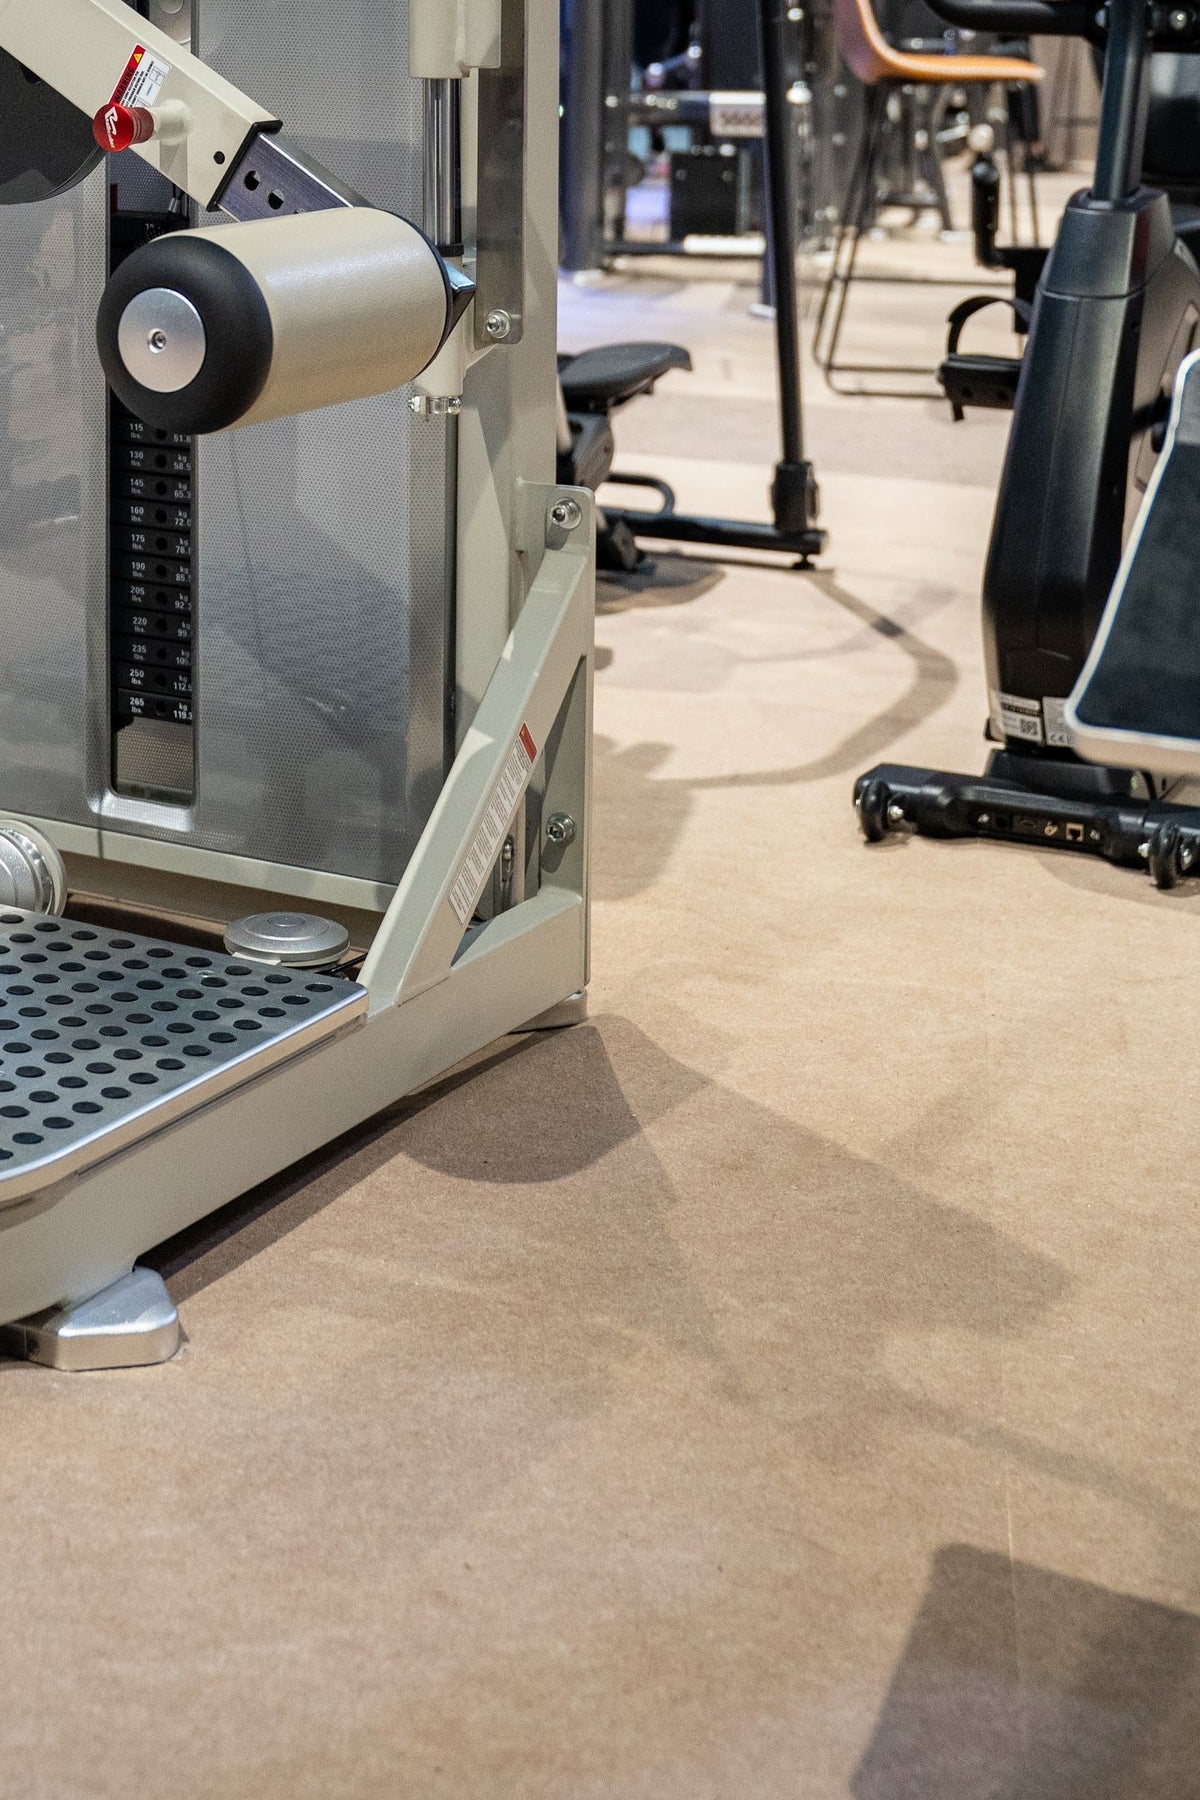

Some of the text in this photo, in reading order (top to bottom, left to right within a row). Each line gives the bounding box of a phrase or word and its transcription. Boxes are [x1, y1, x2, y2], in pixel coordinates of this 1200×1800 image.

[129, 423, 144, 432] 115
[129, 450, 144, 460] 130
[129, 478, 144, 487] 145
[130, 506, 145, 515] 160
[131, 533, 145, 543] 175
[131, 561, 146, 570] 190
[130, 585, 145, 595] 205
[132, 616, 148, 626] 220
[132, 644, 147, 654] 235
[129, 668, 145, 678] 250
[129, 697, 145, 706] 265
[178, 702, 188, 711] kg
